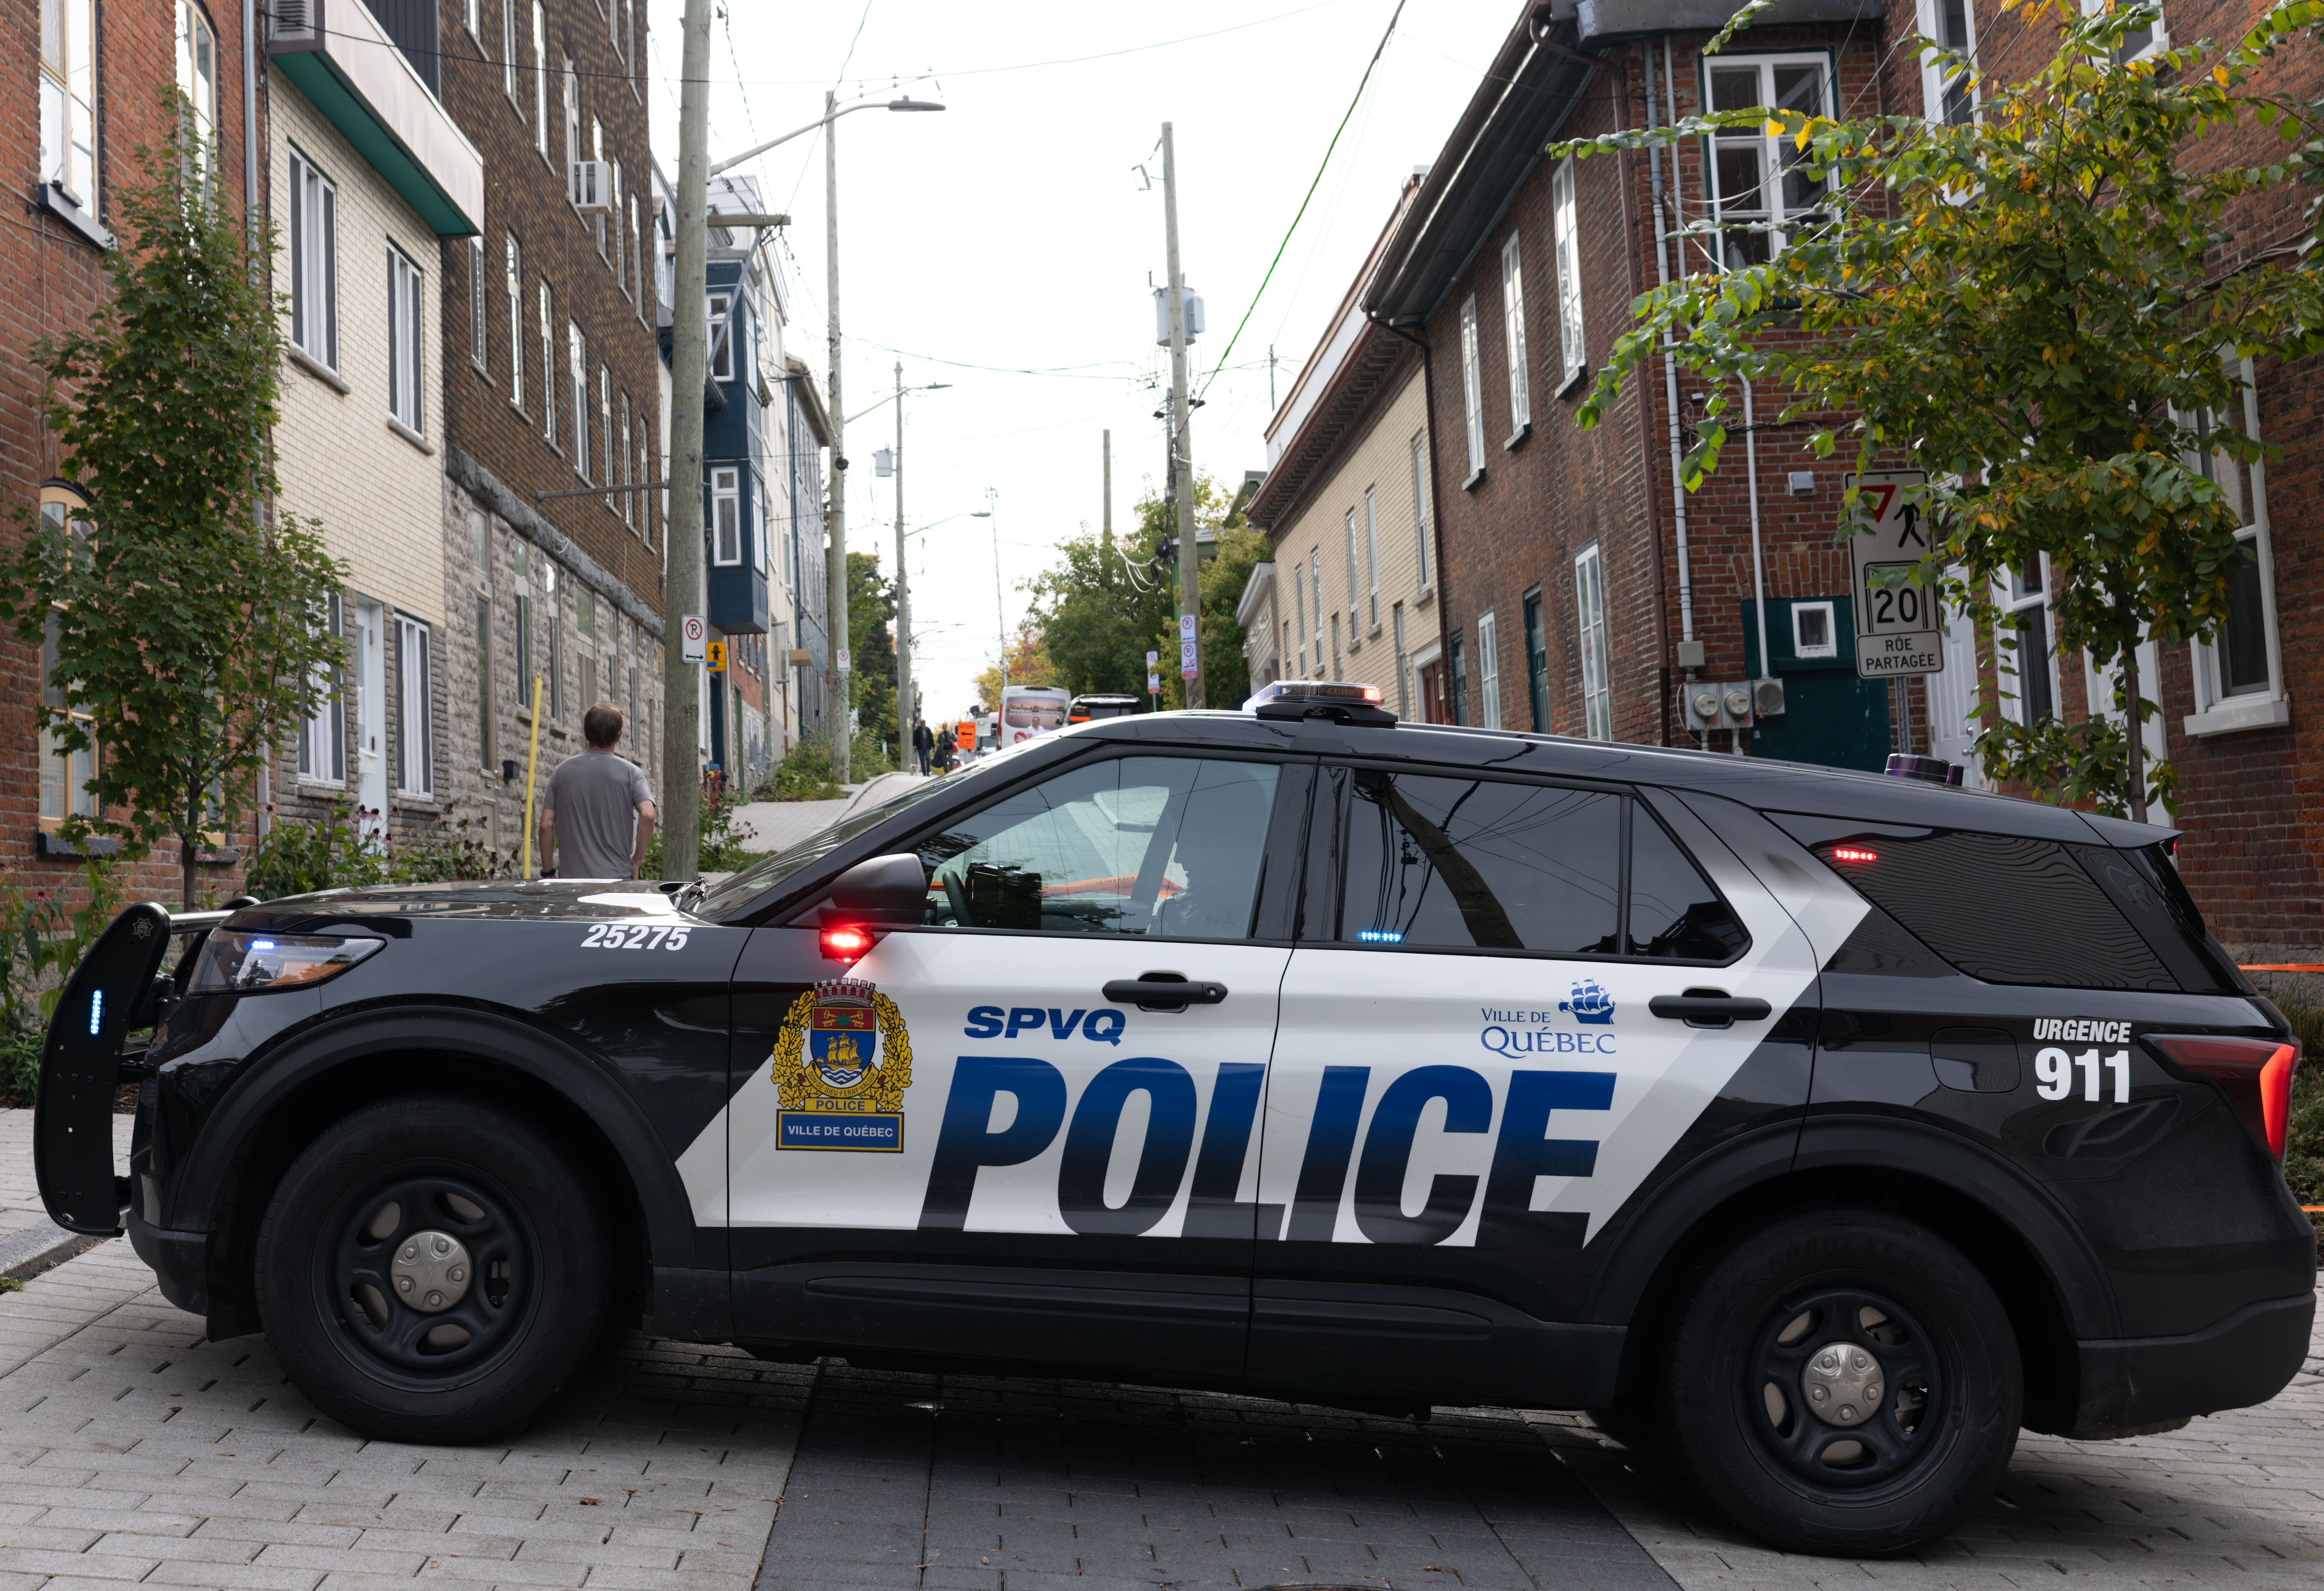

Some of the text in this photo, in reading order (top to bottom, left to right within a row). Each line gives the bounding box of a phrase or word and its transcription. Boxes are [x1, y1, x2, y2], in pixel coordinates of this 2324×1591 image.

[1875, 588, 1918, 623] 20
[1885, 638, 1913, 651] RUE
[1866, 652, 1936, 670] PARTAGÉE
[581, 924, 692, 951] 25275
[964, 1006, 1126, 1047] SPVQ
[1481, 1008, 1551, 1023] VILLE DE
[1481, 1026, 1617, 1059] QUÉBEC
[2034, 1019, 2132, 1043] URGENCE
[808, 1071, 818, 1085] DON
[816, 1082, 825, 1090] DE
[825, 1087, 838, 1097] DIEU
[859, 1072, 877, 1091] VALOIR
[2035, 1047, 2130, 1103] 911
[816, 1100, 865, 1111] POLICE
[788, 1125, 893, 1137] VILLE DE QUÉBEC
[917, 1055, 1618, 1248] POLICE
